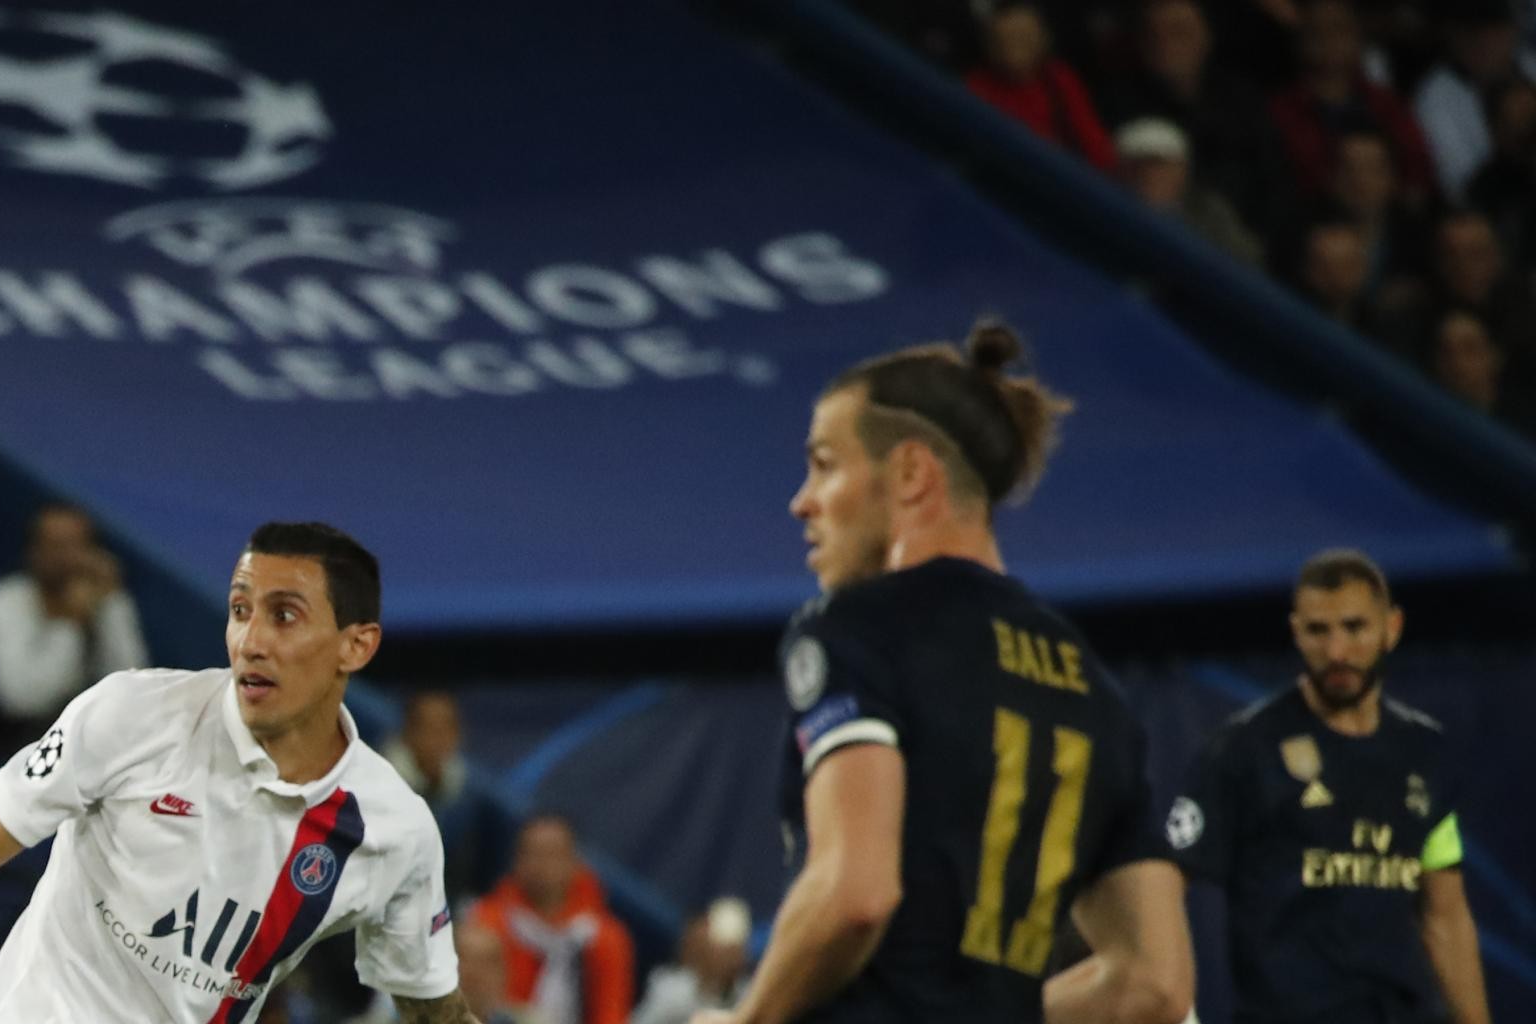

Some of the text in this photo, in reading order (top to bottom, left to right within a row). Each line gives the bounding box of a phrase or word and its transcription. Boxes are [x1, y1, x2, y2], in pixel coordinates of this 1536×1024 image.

[199, 329, 728, 400] LEAGUE
[990, 617, 1089, 696] BALE
[960, 706, 1093, 976] 11
[1302, 848, 1422, 892] Emirate
[95, 900, 148, 960] ACCOR
[151, 955, 192, 984] LIVE
